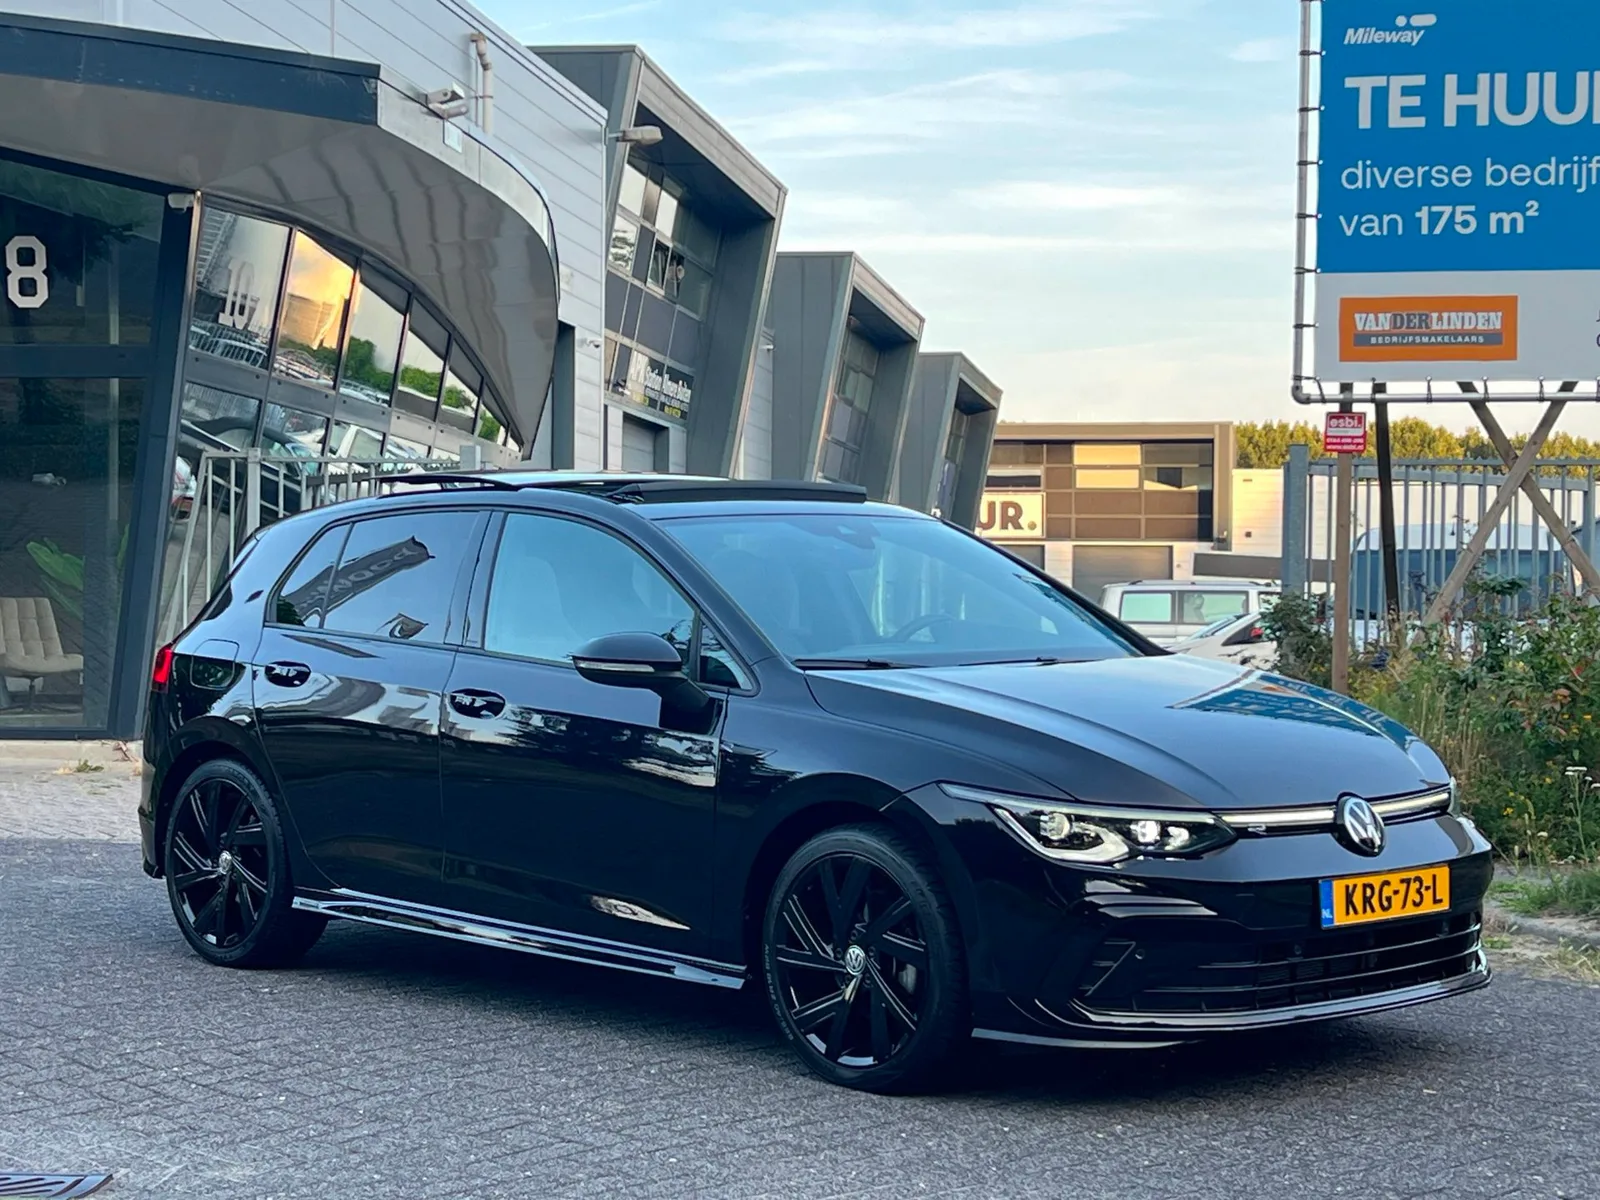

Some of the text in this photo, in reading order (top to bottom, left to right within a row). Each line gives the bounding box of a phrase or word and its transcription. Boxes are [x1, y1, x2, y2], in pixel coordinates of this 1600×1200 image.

[1343, 27, 1425, 46] Mileway
[1344, 71, 1600, 129] TE HUU
[1341, 160, 1473, 189] diverse
[1339, 200, 1540, 236] van 175 m²
[5, 235, 49, 308] 8
[218, 257, 255, 330] 10
[1370, 336, 1484, 344] BEDRIJFSMAKELAARS
[1345, 874, 1443, 916] KRG-73-L
[1321, 908, 1333, 919] NL
